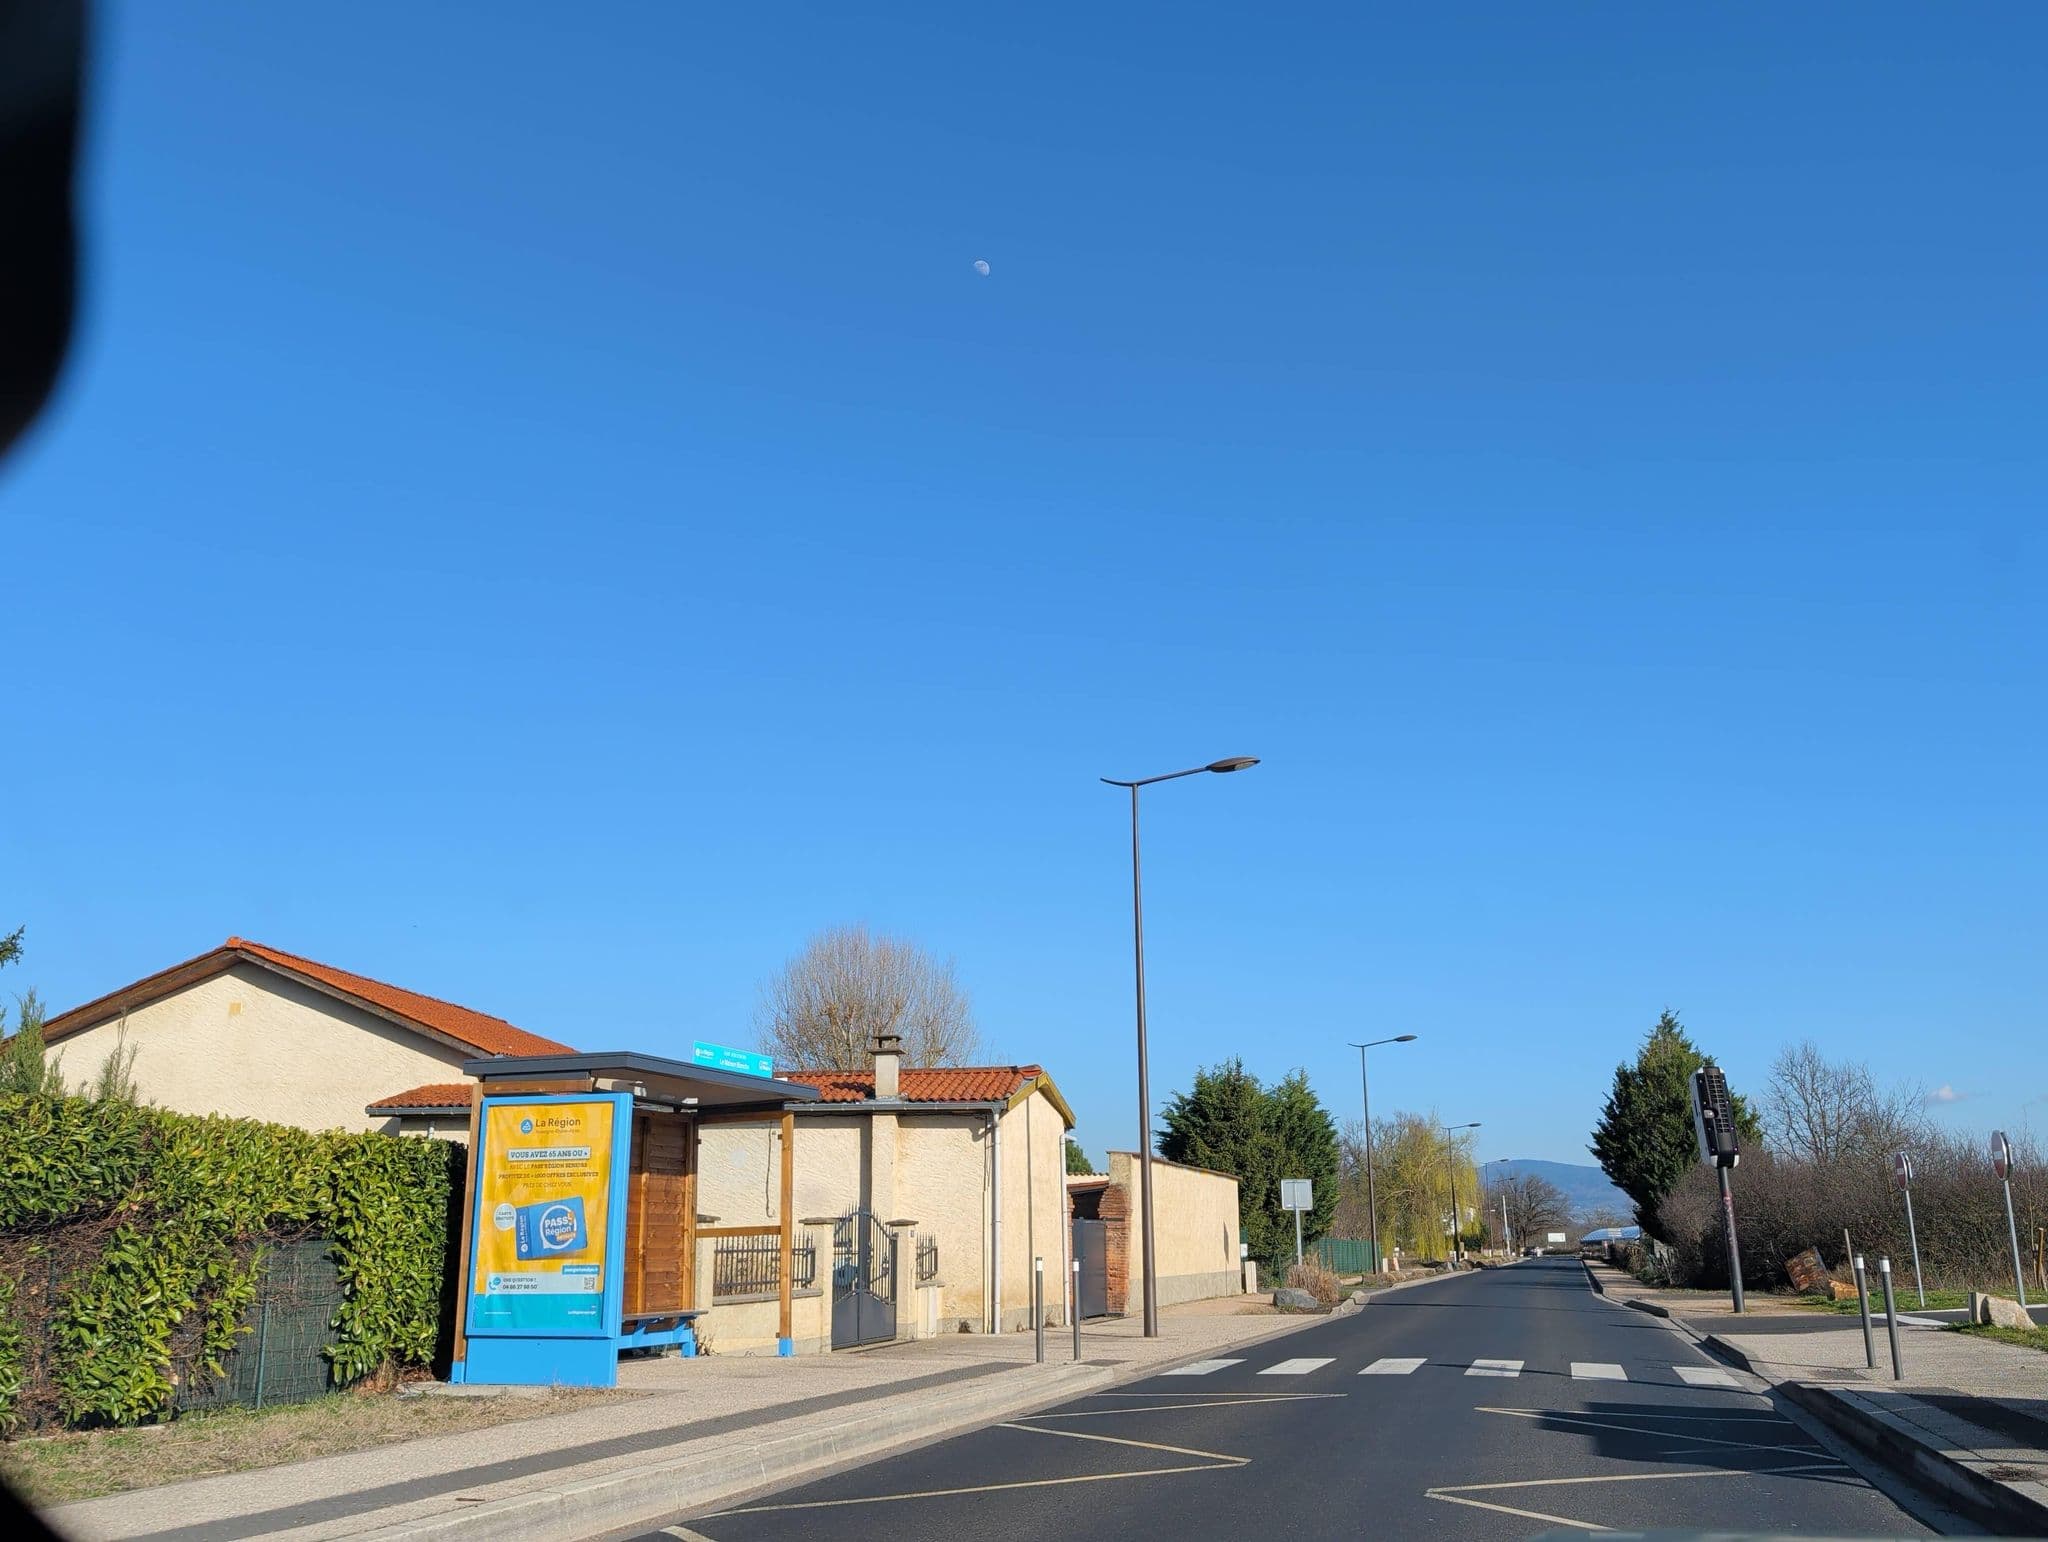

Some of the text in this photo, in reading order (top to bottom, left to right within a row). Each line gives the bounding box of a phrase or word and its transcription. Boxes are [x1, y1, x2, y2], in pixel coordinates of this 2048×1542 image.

[536, 1117, 581, 1128] La Région
[510, 1151, 530, 1159] VOUS
[530, 1150, 548, 1158] AVEZ
[545, 1226, 572, 1237] Région
